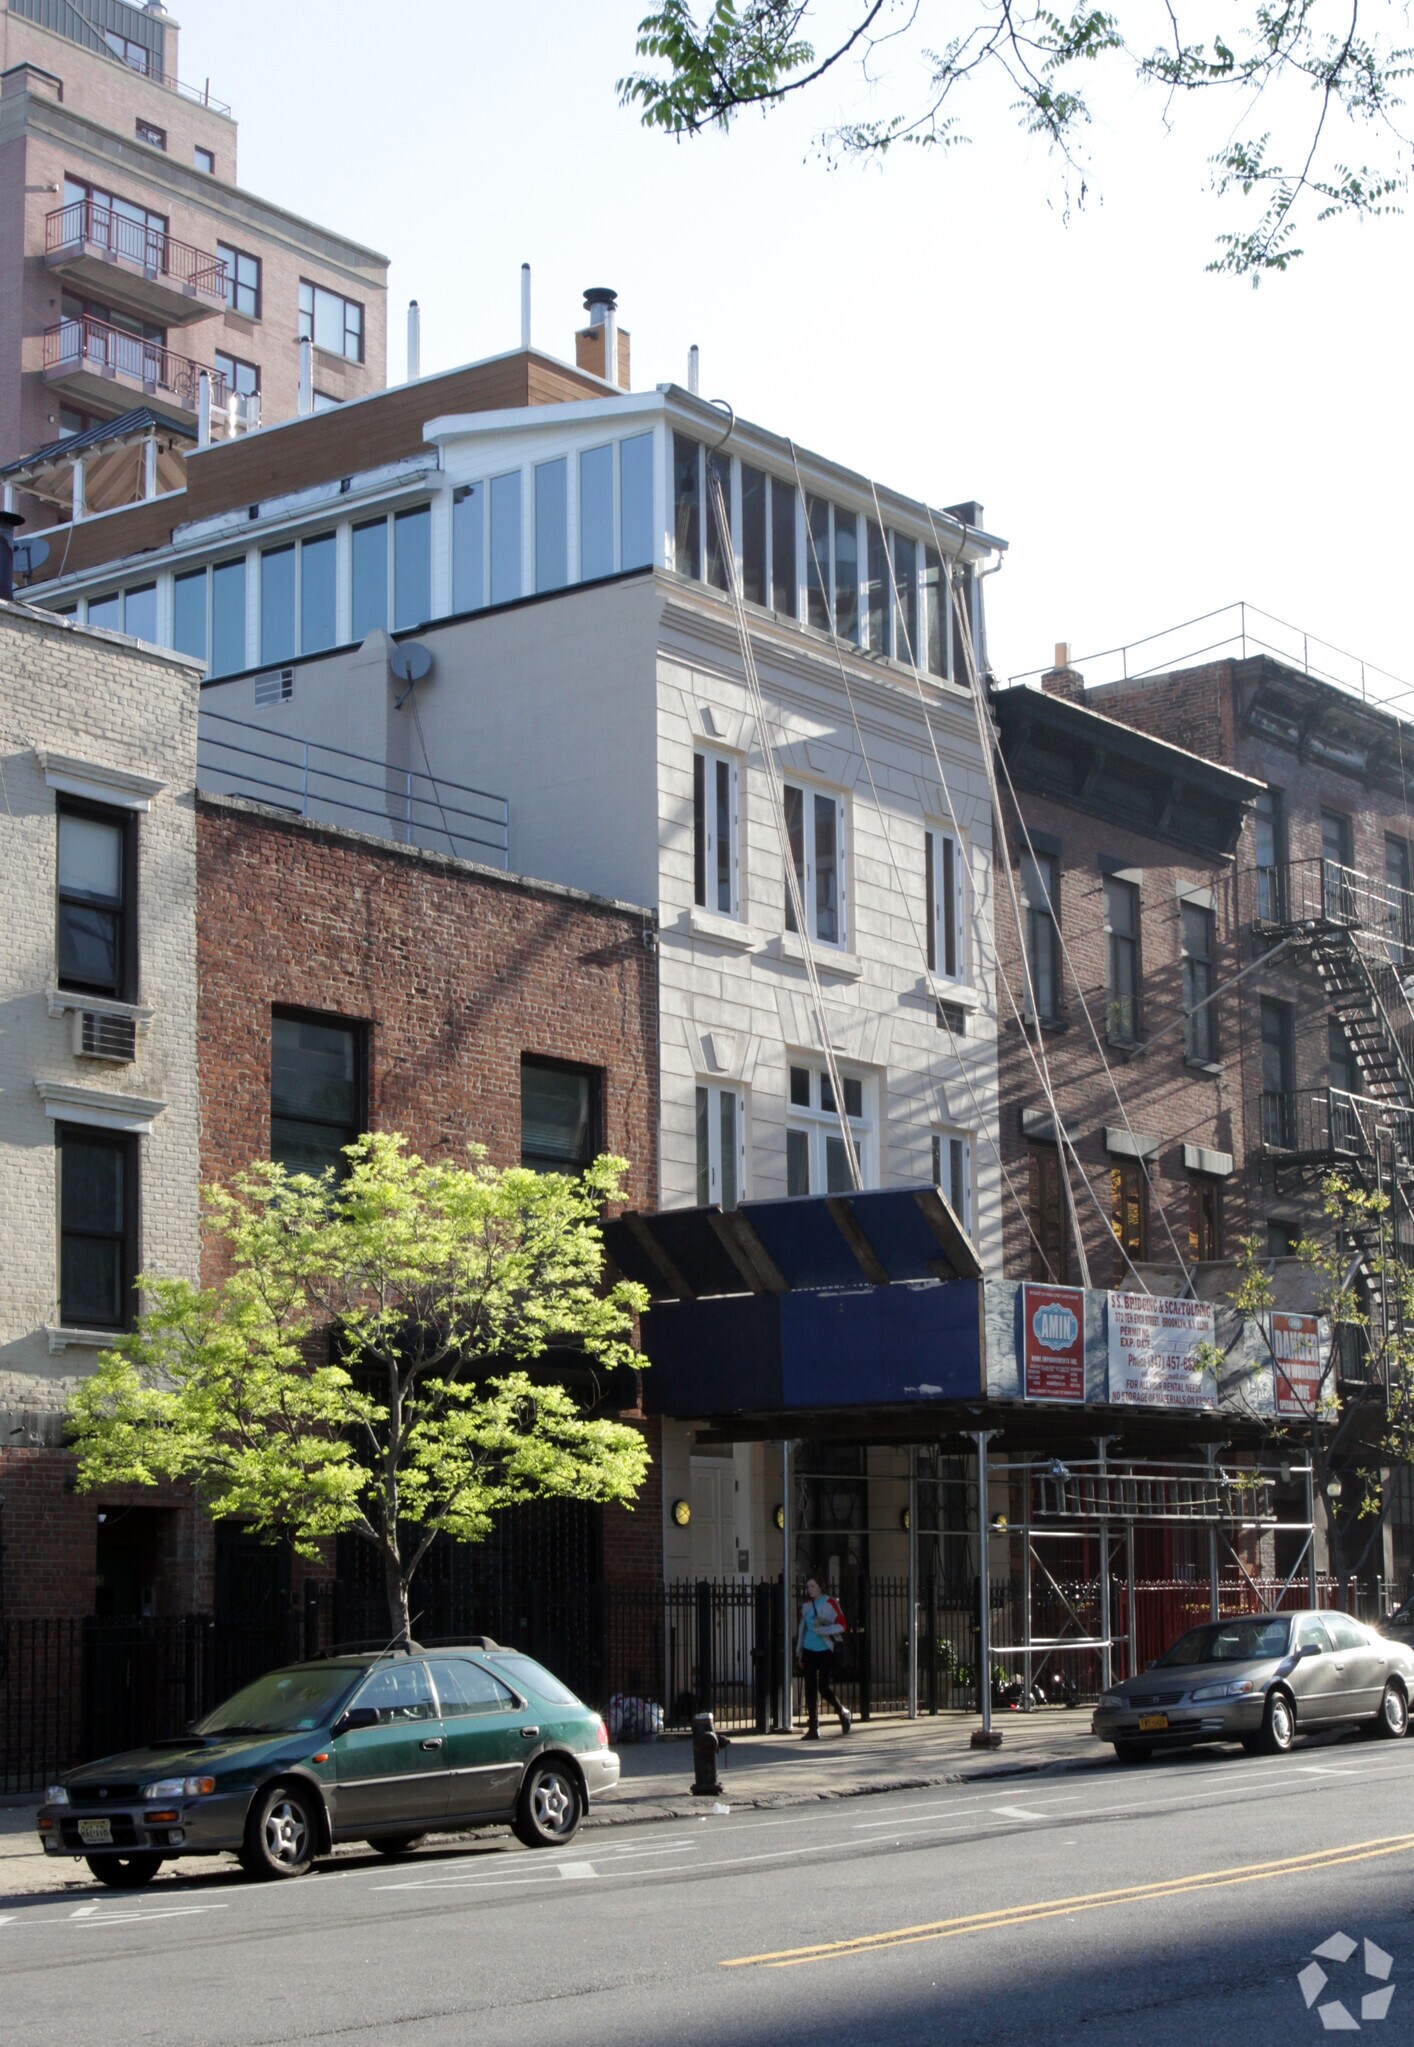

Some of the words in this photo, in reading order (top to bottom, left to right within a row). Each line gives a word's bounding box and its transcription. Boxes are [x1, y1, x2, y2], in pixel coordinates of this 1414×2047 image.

[1159, 1299, 1165, 1313] &
[1041, 1313, 1071, 1340] AMIN
[1120, 1327, 1141, 1337] PERMIT
[1120, 1338, 1136, 1347] EXP.
[1274, 1330, 1319, 1362] DANGER
[1126, 1379, 1139, 1389] FOR
[1121, 1391, 1148, 1402] STORAGE
